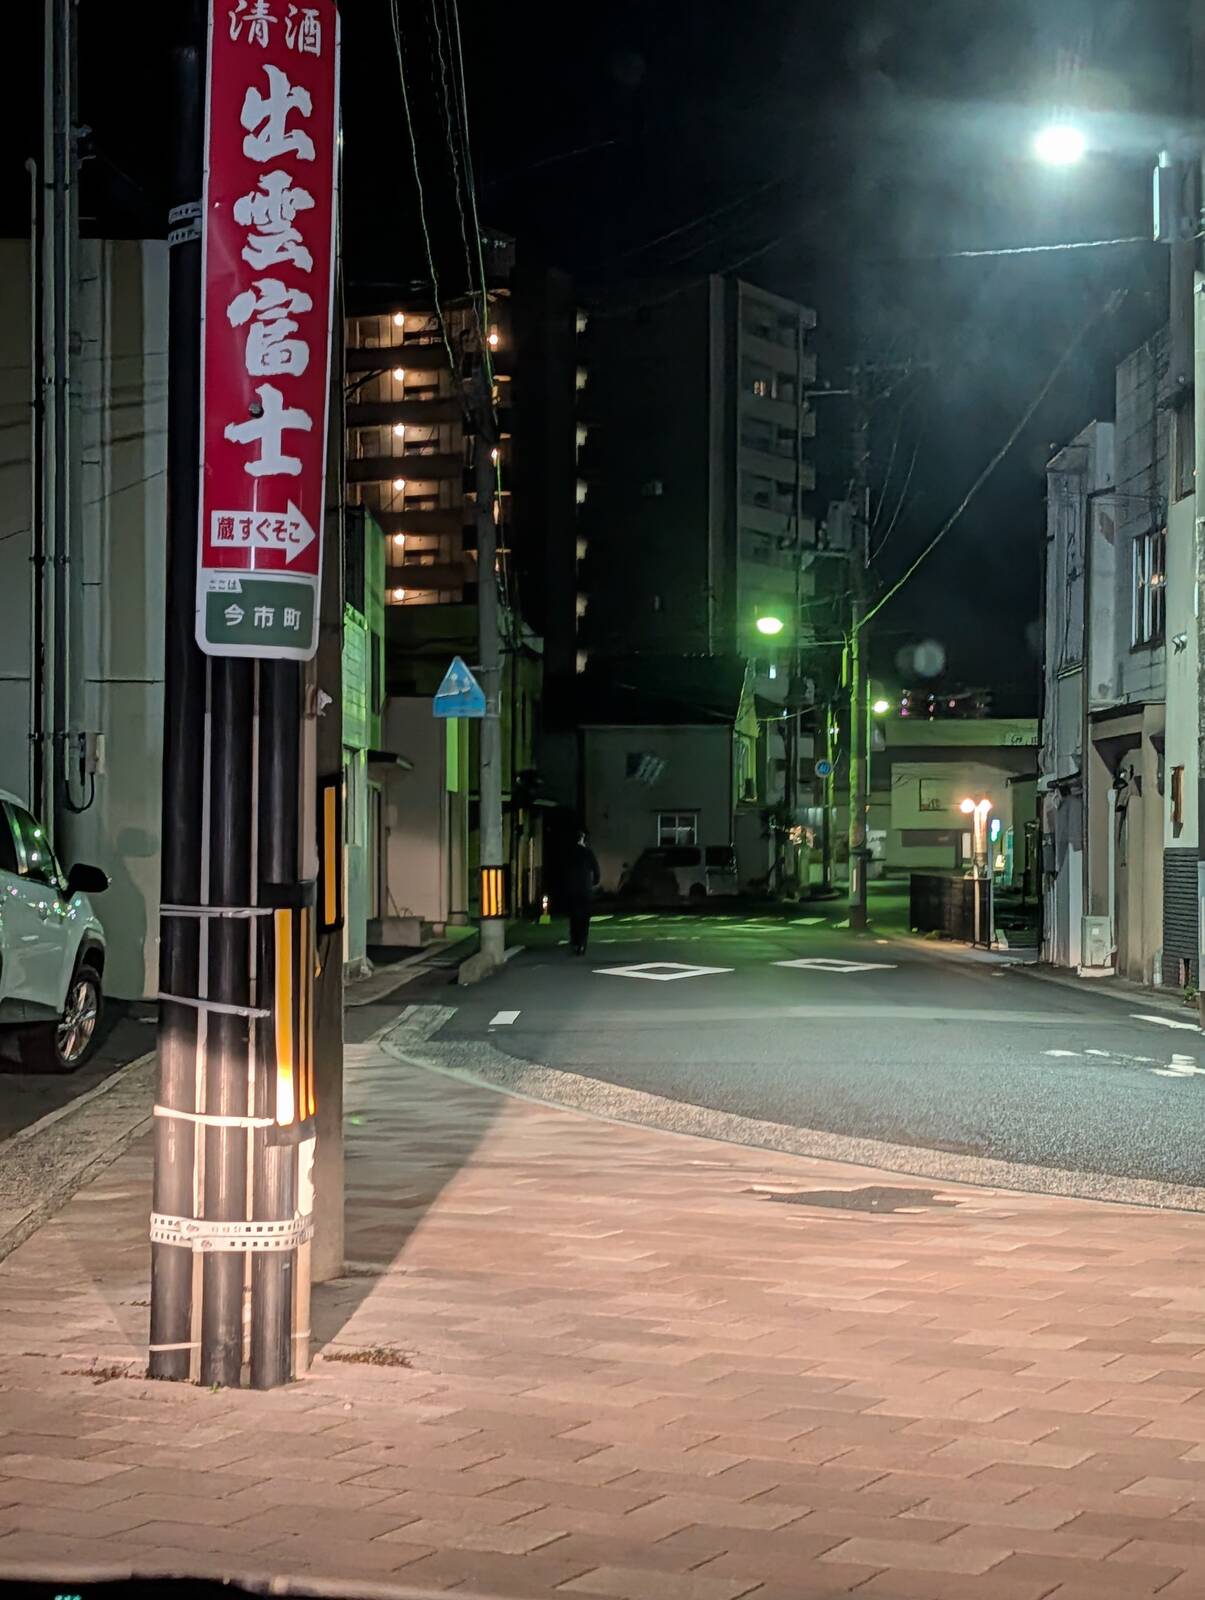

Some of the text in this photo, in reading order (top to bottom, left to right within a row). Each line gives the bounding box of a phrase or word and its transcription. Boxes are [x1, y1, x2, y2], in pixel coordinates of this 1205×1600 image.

[228, 0, 322, 58] 清酒
[223, 63, 316, 477] 出雲富士
[216, 516, 301, 543] 蔵すぐそこ
[209, 579, 237, 591] ここは
[224, 603, 301, 631] 今市町
